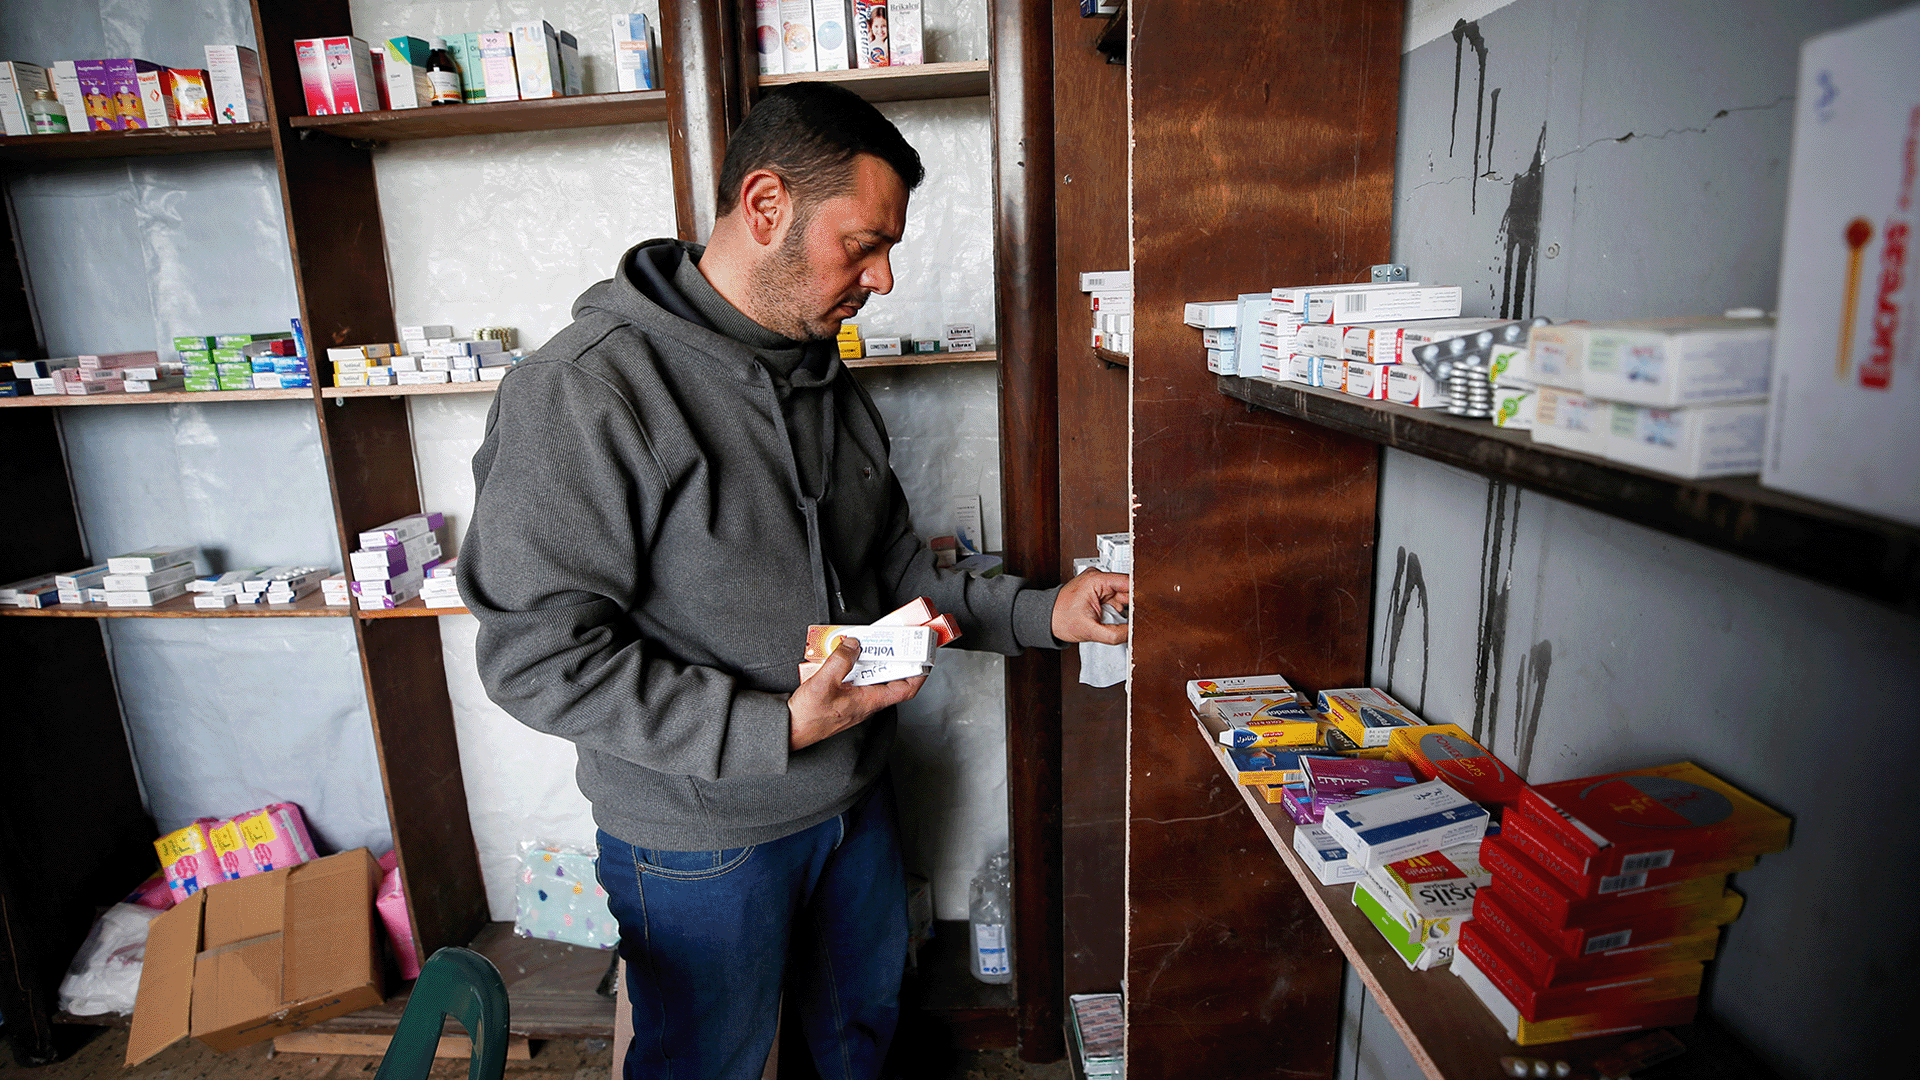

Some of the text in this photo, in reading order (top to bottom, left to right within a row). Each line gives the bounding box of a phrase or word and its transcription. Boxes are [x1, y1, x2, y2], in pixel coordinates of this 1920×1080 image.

[516, 26, 541, 42] FLU
[1433, 735, 1486, 777] POWER CAPS
